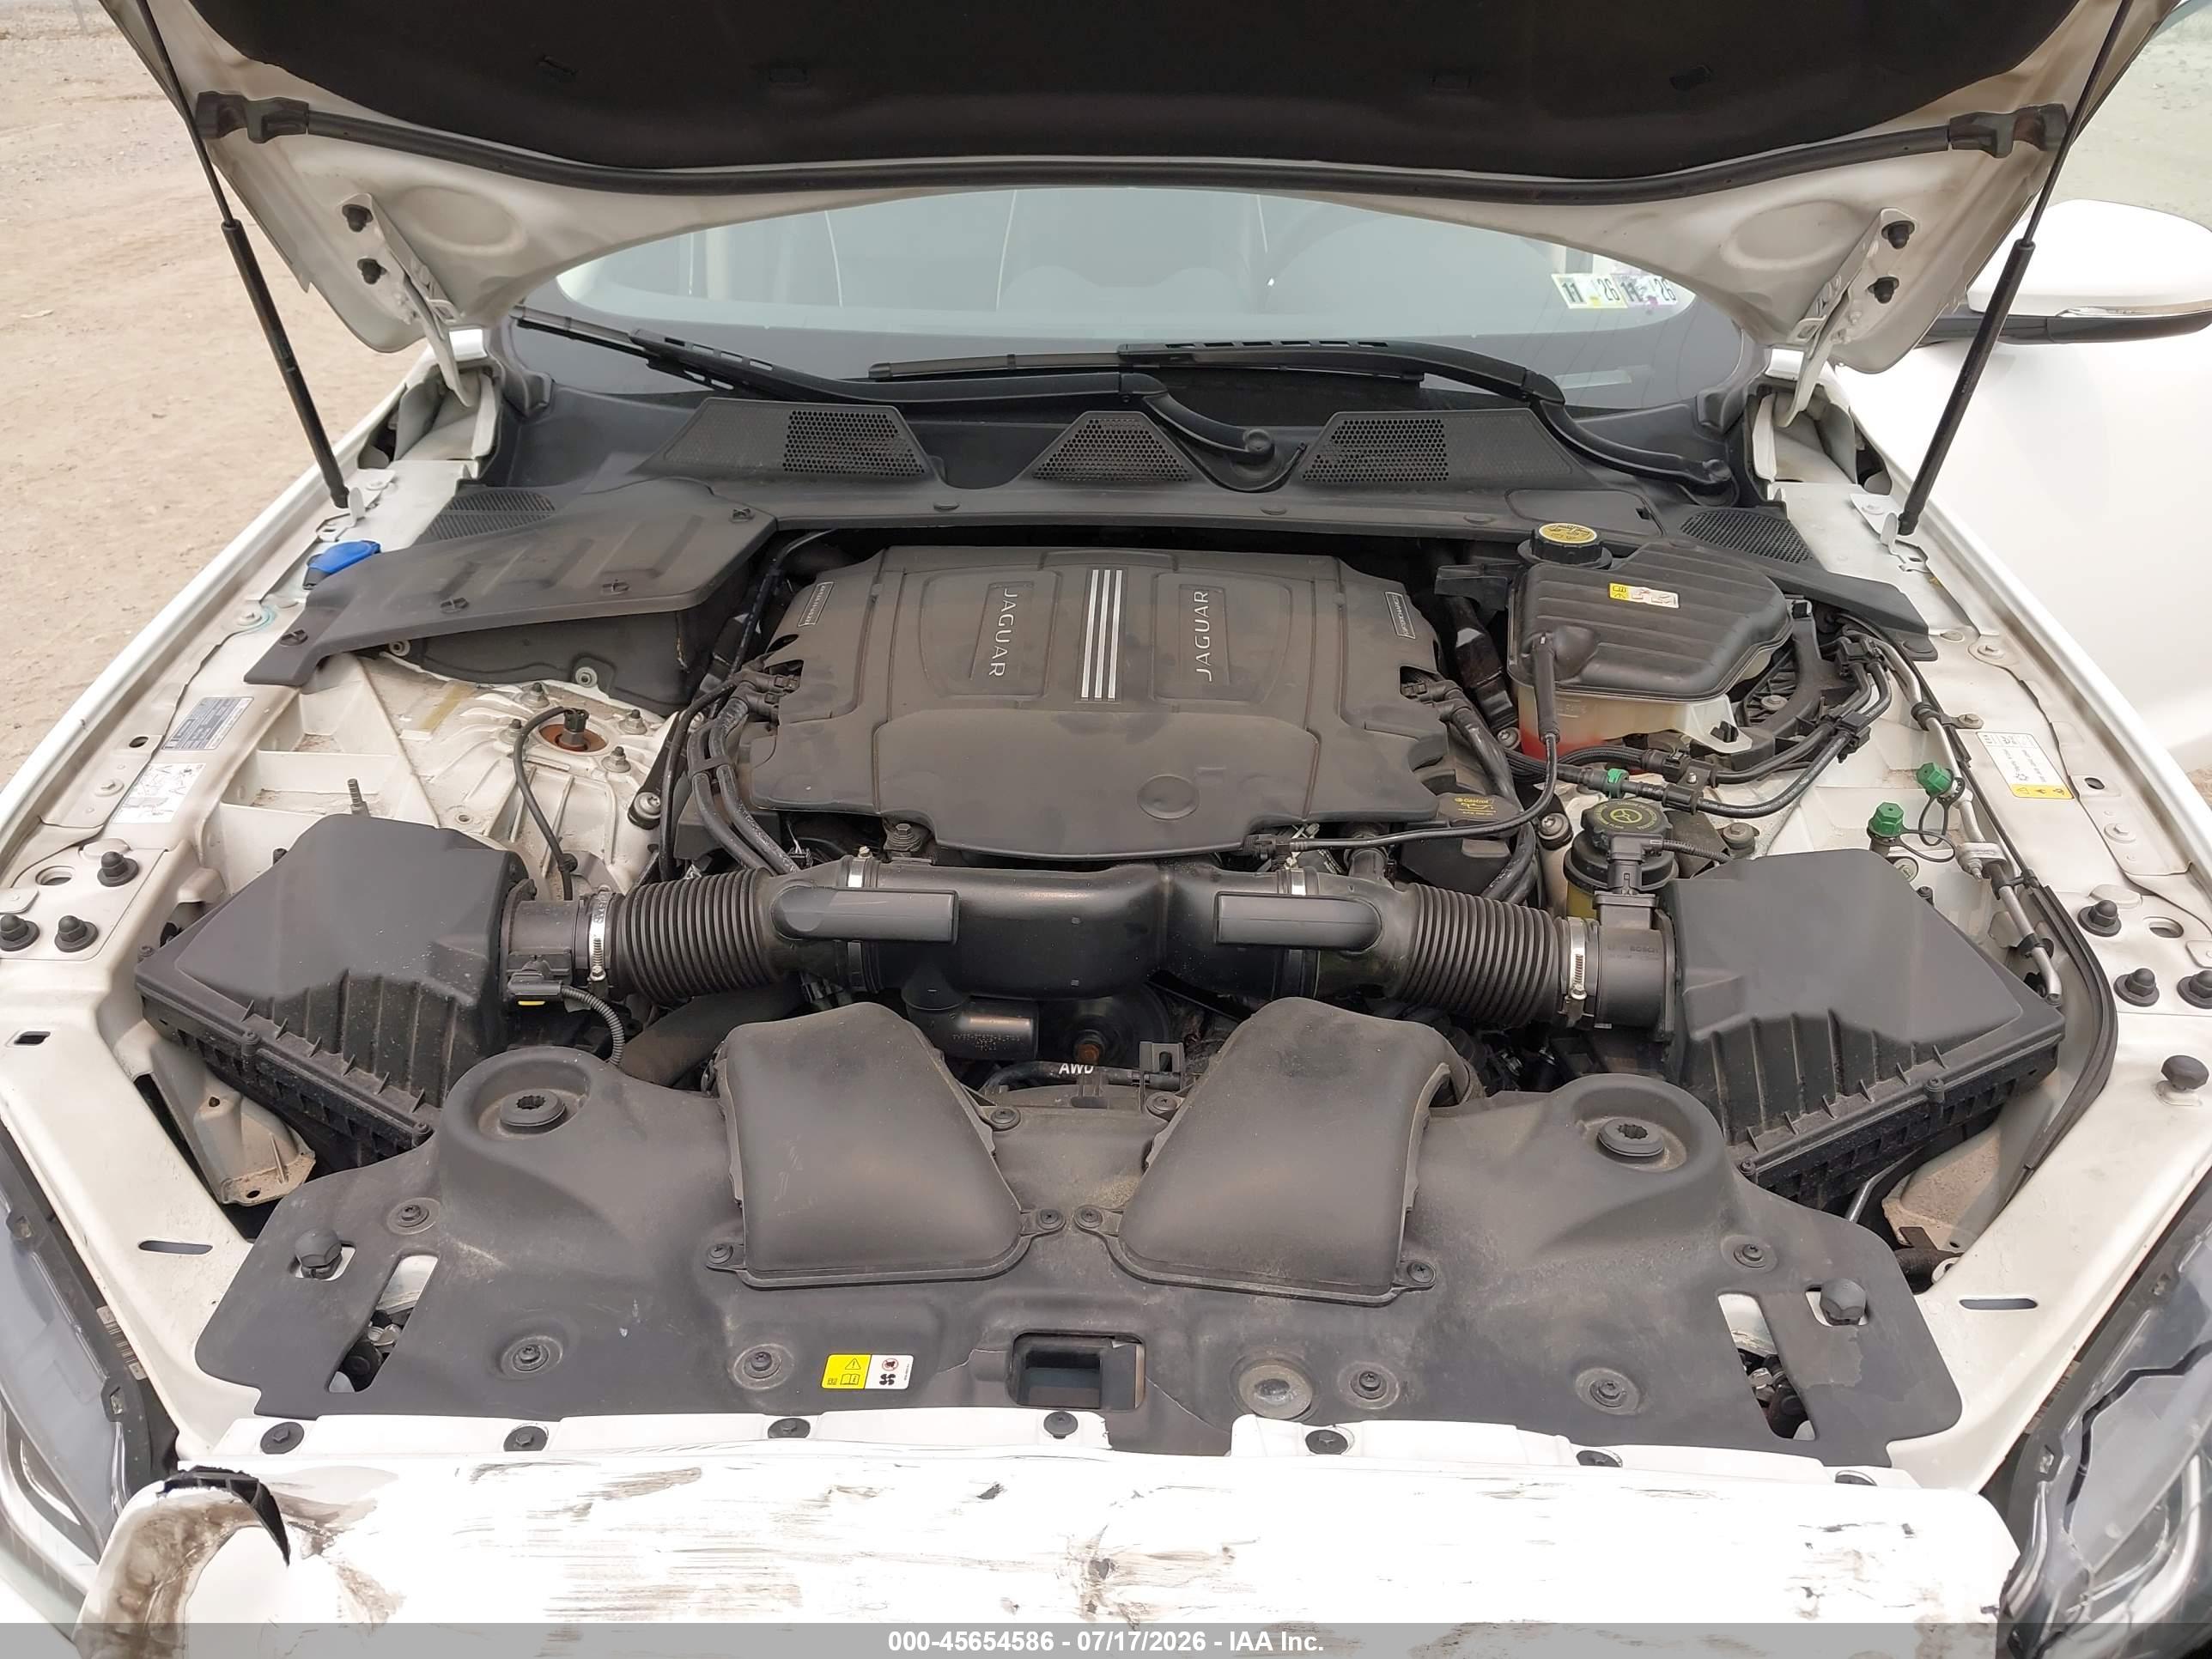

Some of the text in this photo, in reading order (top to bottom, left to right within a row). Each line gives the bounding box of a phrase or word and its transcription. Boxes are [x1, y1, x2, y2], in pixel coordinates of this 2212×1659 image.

[1562, 278, 1620, 303] 11 26
[1654, 277, 1677, 301] 26
[988, 588, 1018, 677] JAGUAR
[1194, 591, 1212, 683] JAGUAR
[1058, 1062, 1094, 1074] AWD
